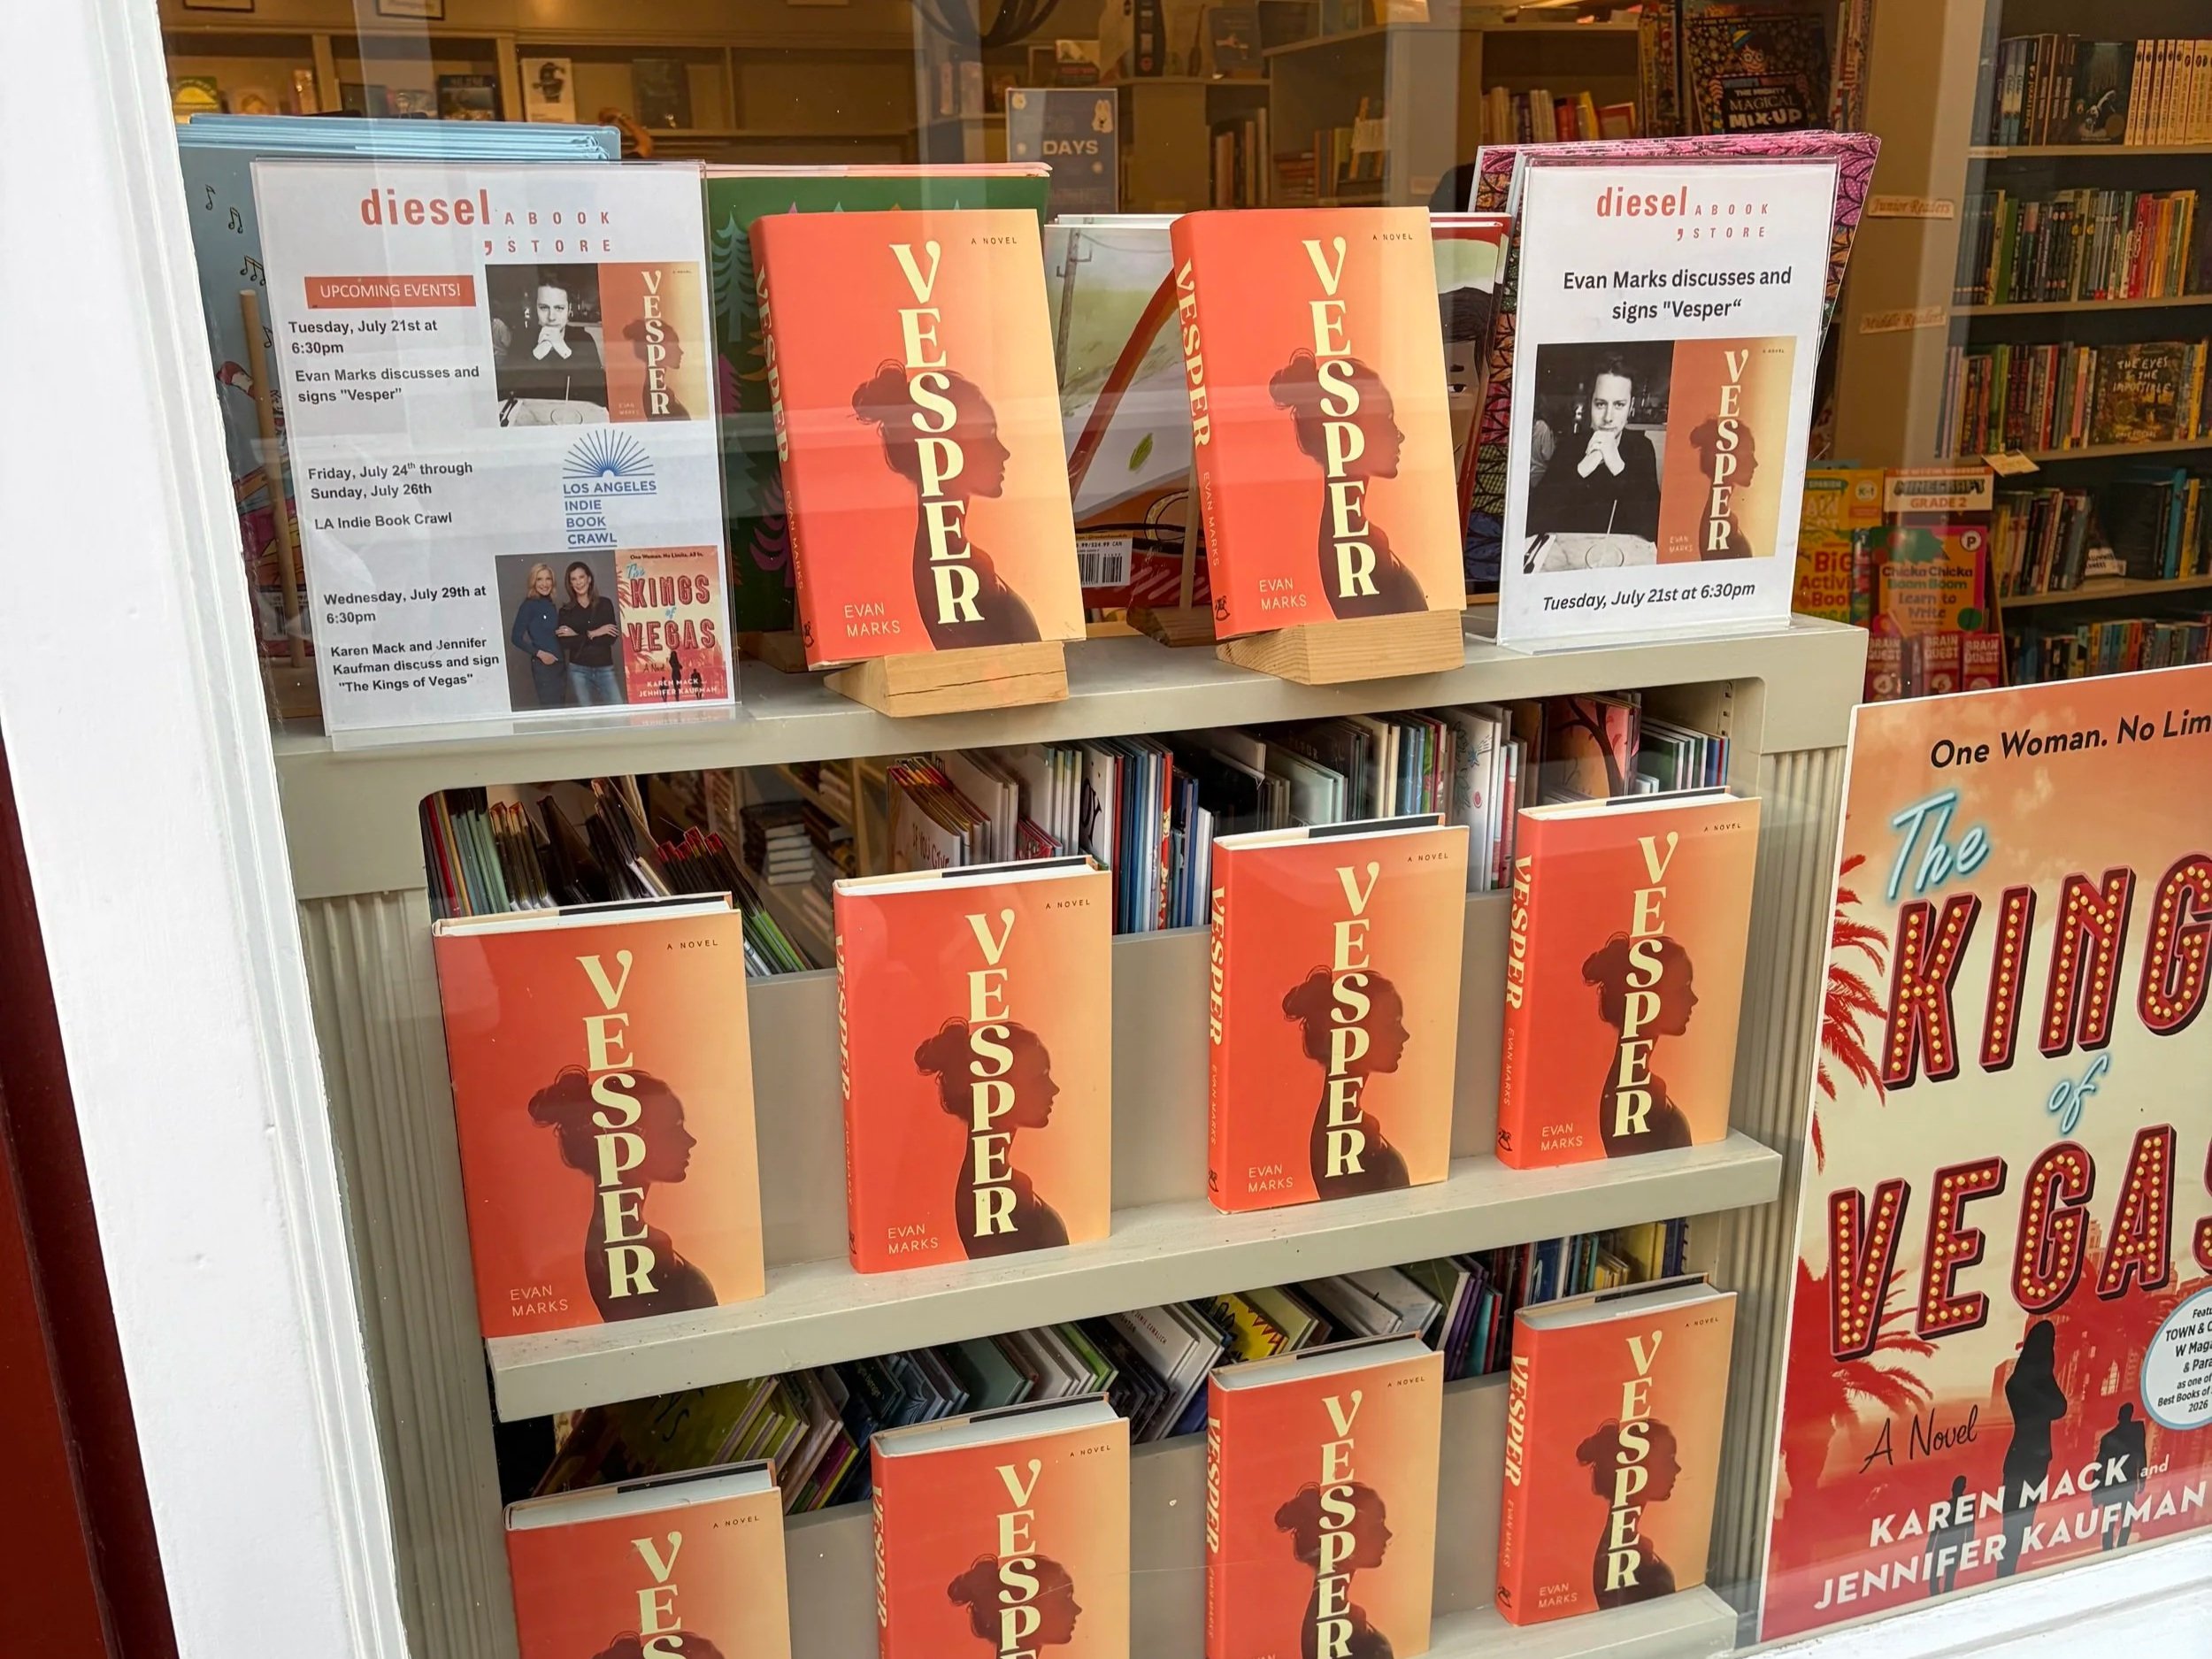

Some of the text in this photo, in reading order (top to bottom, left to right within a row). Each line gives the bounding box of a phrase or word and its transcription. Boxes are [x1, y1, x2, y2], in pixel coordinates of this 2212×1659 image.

[1729, 95, 1797, 111] MAGICAL
[1042, 140, 1099, 156] DAYS
[361, 188, 490, 226] diesel
[1596, 186, 1686, 219] diesel
[983, 235, 1018, 244] NOVEL
[1563, 266, 1792, 289] Evan Marks discusses and
[320, 282, 461, 299] UPCOMING EVENTS!
[1612, 302, 1657, 323] signs
[288, 319, 438, 334] Tuesday, July 21st at
[291, 341, 344, 357] 6:30pm
[641, 269, 672, 416] VESPER
[1175, 260, 1210, 449] VESPER
[296, 365, 480, 382] Evan Marks discusses and
[298, 389, 336, 405] signs
[1302, 235, 1380, 599] VESPER
[888, 240, 985, 625] VESPER
[1707, 350, 1750, 552] VESPER
[308, 465, 356, 482] Friday,
[359, 465, 388, 480] July
[419, 461, 473, 478] through
[311, 482, 432, 502] Sunday, July 26th
[564, 480, 657, 495] LOS ANGELES
[565, 499, 602, 511] INDIE
[1910, 496, 1967, 509] GRADE 2
[314, 511, 452, 530] LA Indie Book Crawl
[566, 516, 606, 528] BOOK
[568, 532, 618, 545] CRAWL
[1882, 566, 1972, 577] Chicka Chicka
[631, 575, 711, 609] KINGS
[1259, 577, 1294, 593] EVAN
[324, 586, 487, 606] Wednesday, July 29th at
[1261, 594, 1308, 611] MARKS
[1543, 582, 1755, 612] Tuesday, July 21st at 6:30pm
[326, 611, 376, 626] 6:30pm
[843, 603, 885, 618] EVAN
[627, 619, 717, 653] VEGAS
[847, 619, 901, 638] MARKS
[330, 636, 488, 657] Karen Mack and Jennifer
[333, 653, 500, 676] Kaufman discuss and sign
[372, 676, 410, 692] Kings
[411, 675, 426, 688] of
[1931, 738, 1990, 768] One
[2001, 727, 2108, 760] Woman.
[2117, 717, 2155, 745] No
[1888, 792, 1991, 901] The
[1418, 852, 1449, 861] NOVEL
[1057, 899, 1091, 909] NOVEL
[1506, 855, 1532, 1010] VESPER
[680, 939, 718, 949] NOVEL
[1210, 885, 1225, 1046] VESPER
[1612, 831, 1679, 1138] VESPER
[1325, 861, 1380, 1179] VESPER
[964, 908, 1018, 1239] VESPER
[2049, 1053, 2109, 1135] of
[576, 949, 658, 1300] VESPER
[1542, 1123, 1573, 1138] EVAN
[1540, 1135, 1583, 1151] MARKS
[1248, 1164, 1282, 1179] EVAN
[1248, 1177, 1294, 1193] MARKS
[887, 1224, 926, 1239] EVAN
[888, 1237, 939, 1254] MARKS
[510, 1285, 553, 1301] EVAN
[512, 1299, 568, 1317] MARKS
[2166, 1322, 2205, 1341] TOWN &
[2175, 1344, 2186, 1357] W
[2183, 1362, 2190, 1372] &
[2177, 1380, 2186, 1390] as
[2187, 1378, 2202, 1387] one
[2157, 1386, 2210, 1407] Best Books of
[2188, 1400, 2208, 1413] 2026
[1505, 1355, 1529, 1487] VESPER
[1860, 1404, 1978, 1474] A Novel
[1604, 1330, 1663, 1592] VESPER
[1870, 1454, 2170, 1548] KAREN MACK and
[1815, 1480, 2206, 1610] JENNIFER KAUFMAN
[1540, 1583, 1569, 1596] EVAN
[1539, 1594, 1578, 1609] MARKS
